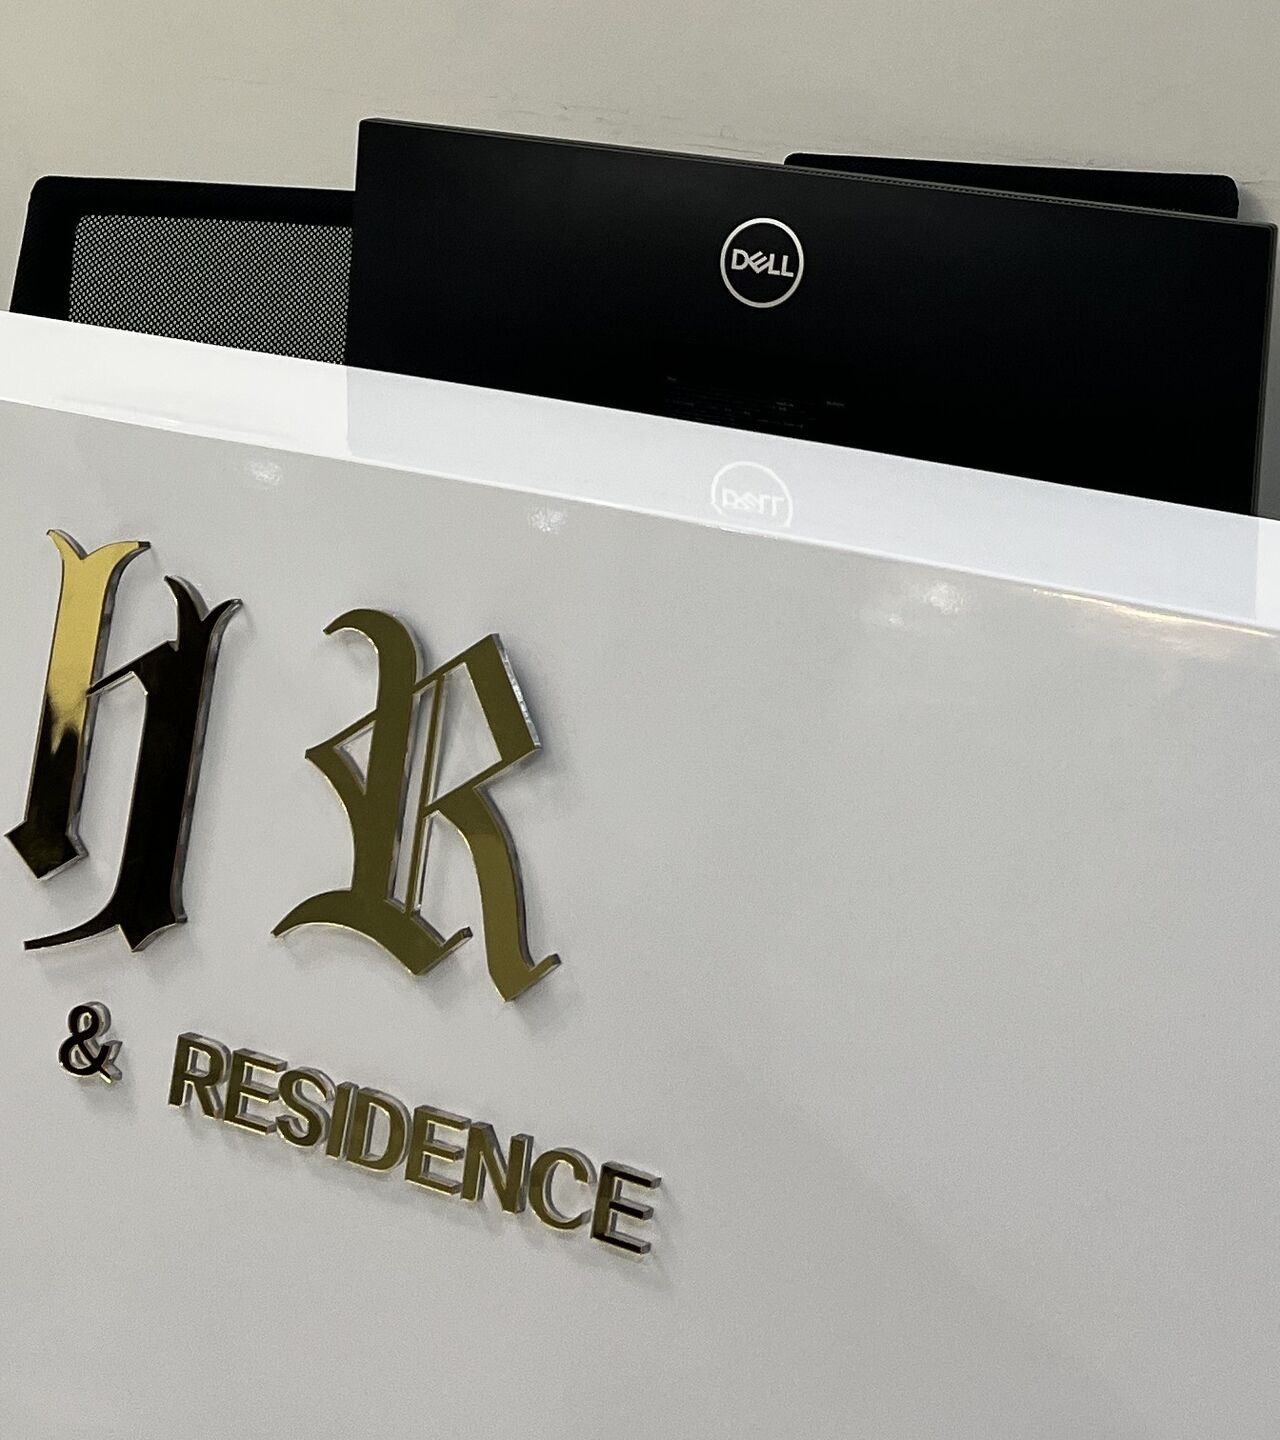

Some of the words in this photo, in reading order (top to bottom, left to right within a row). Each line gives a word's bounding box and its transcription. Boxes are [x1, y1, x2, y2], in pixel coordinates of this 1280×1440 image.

[731, 247, 794, 278] DELL
[58, 1002, 123, 1084] &
[168, 1032, 662, 1254] RESIDENCE
